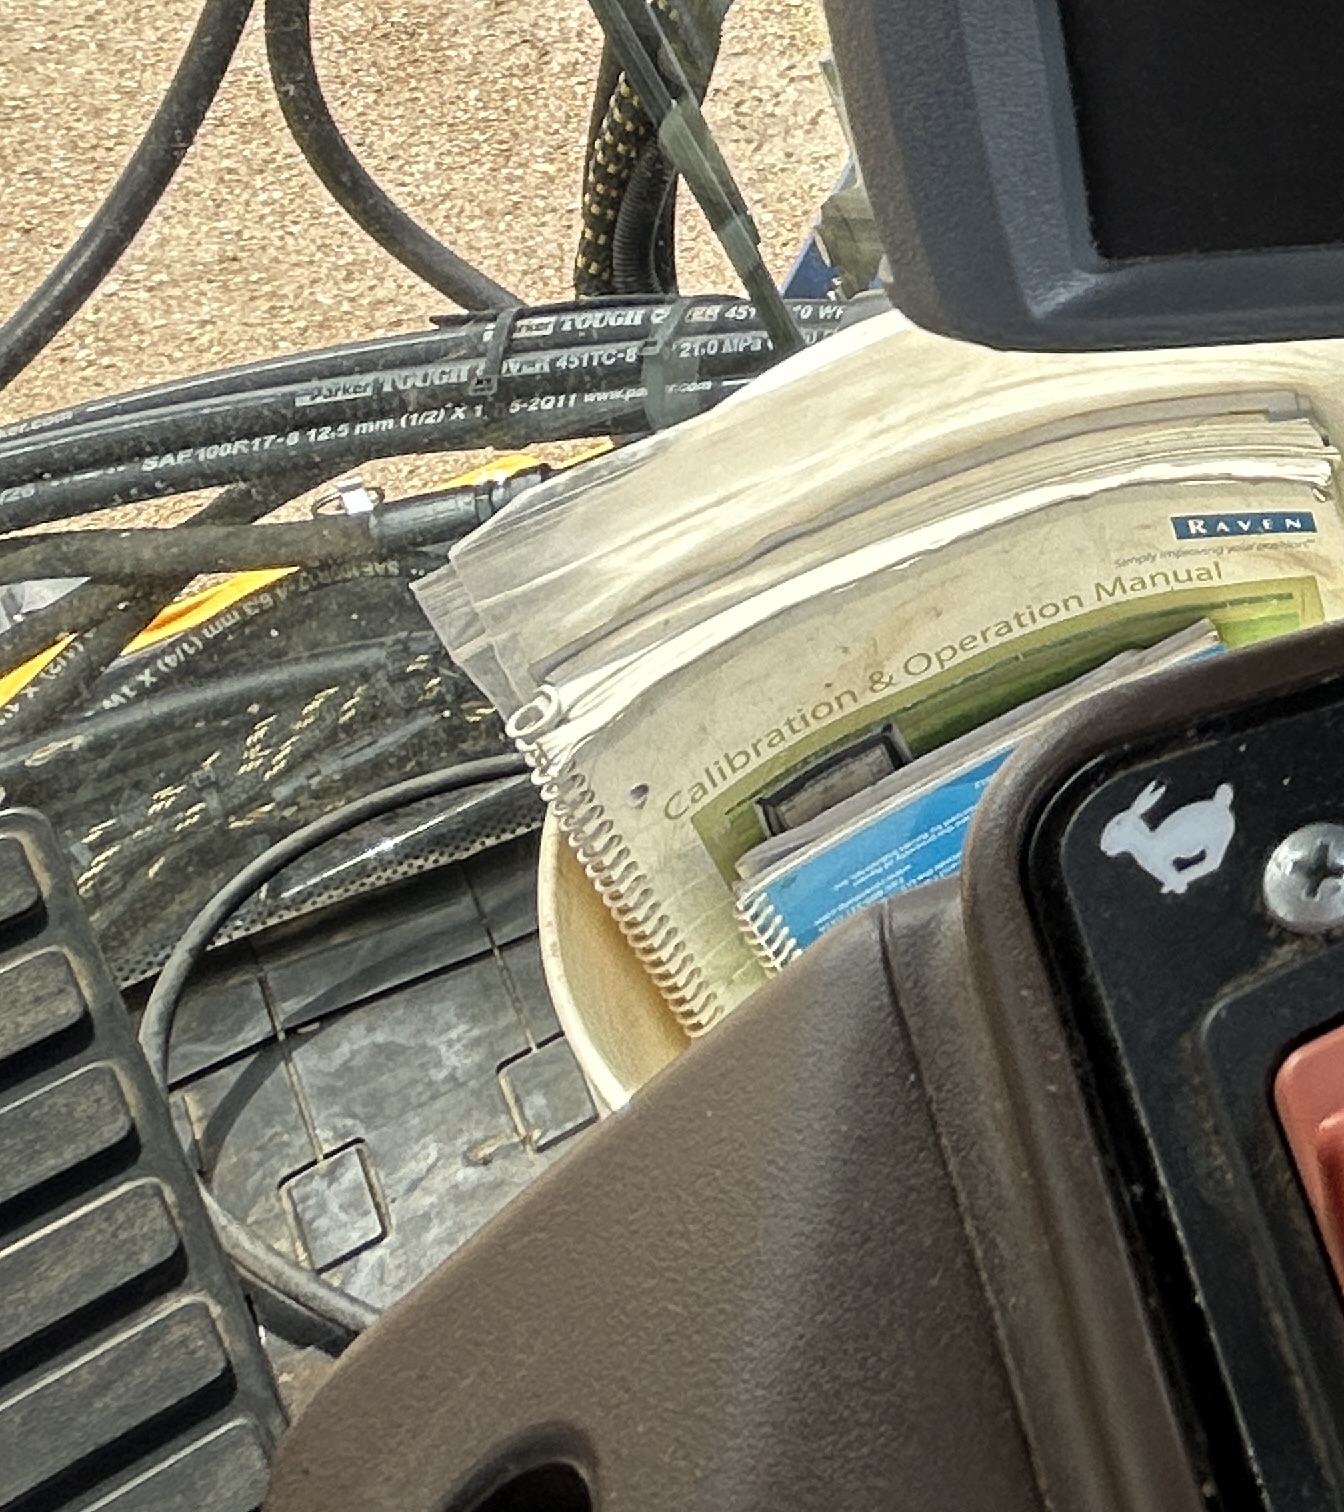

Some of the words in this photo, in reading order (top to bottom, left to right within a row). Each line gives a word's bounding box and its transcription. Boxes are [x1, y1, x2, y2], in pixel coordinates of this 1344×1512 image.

[1187, 517, 1302, 535] RAVEN
[664, 685, 859, 821] Calibration
[867, 669, 894, 695] &
[902, 593, 1086, 679] Operation
[1093, 560, 1223, 602] Manual
